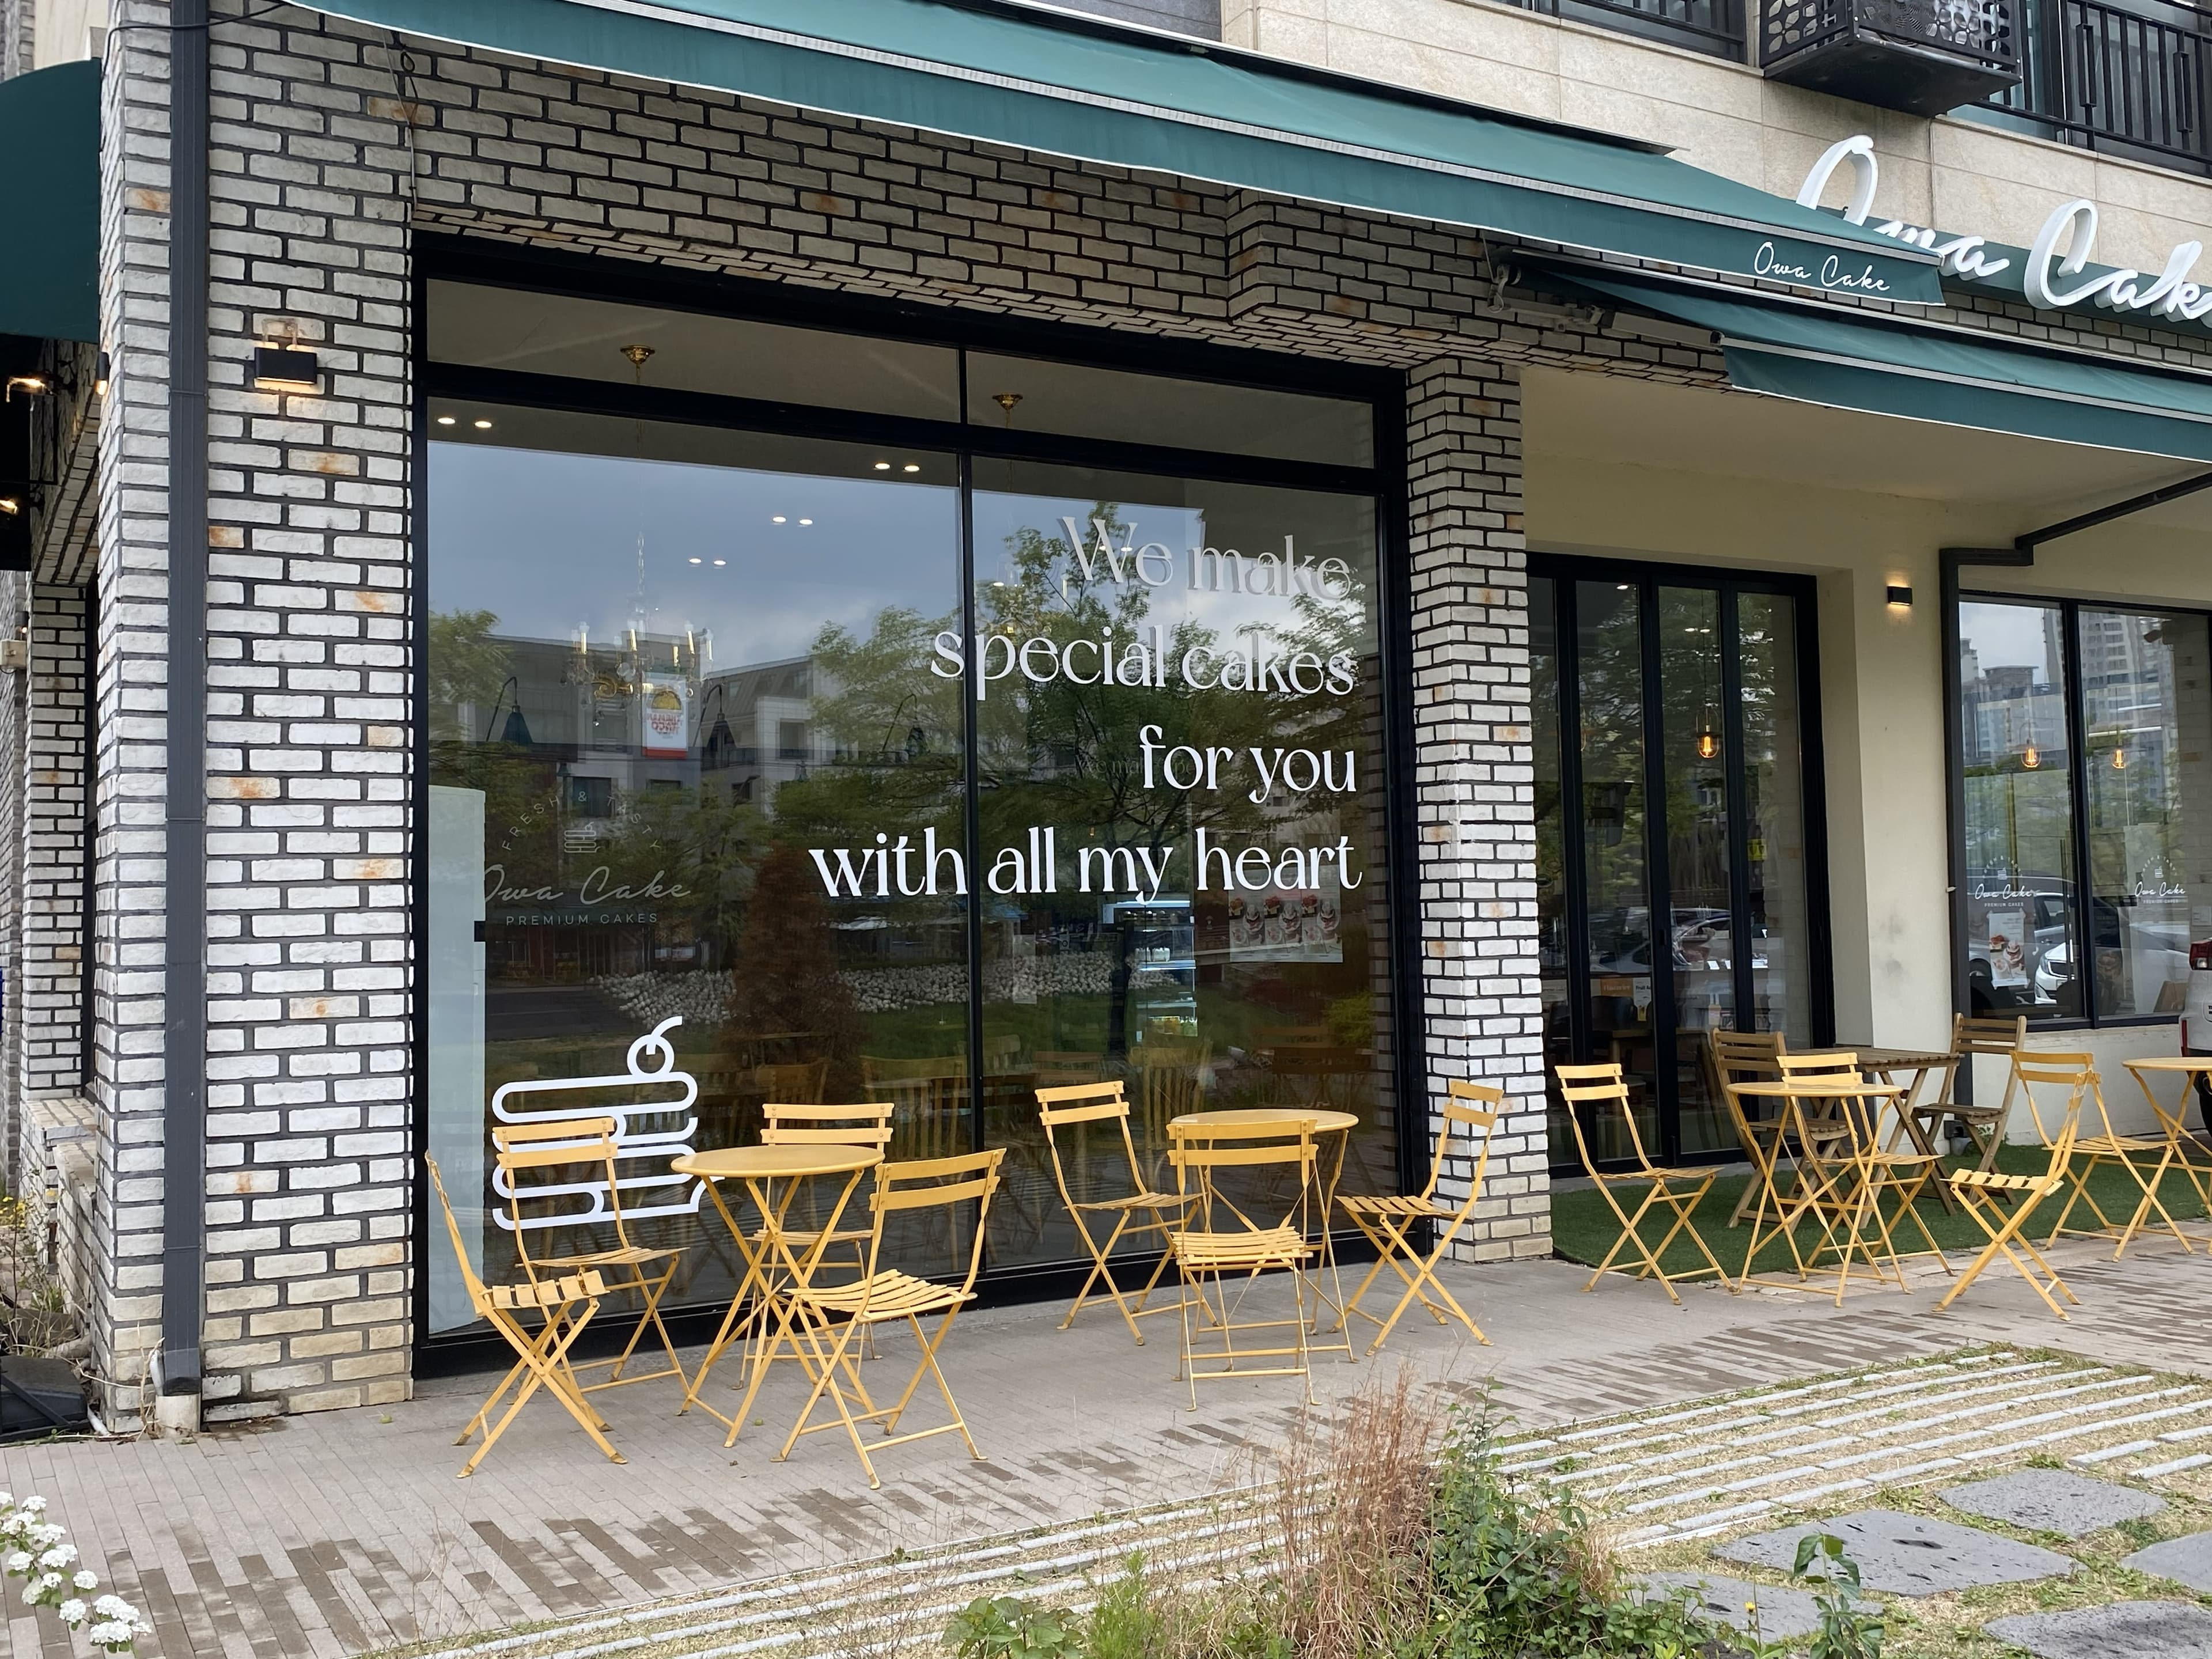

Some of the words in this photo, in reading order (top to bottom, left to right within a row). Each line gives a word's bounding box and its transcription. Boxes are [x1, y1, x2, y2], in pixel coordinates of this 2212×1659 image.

[1754, 241, 1812, 279] Owa
[1821, 255, 1890, 291] Cake
[2024, 199, 2212, 328] Cak
[1060, 516, 1173, 585] We
[1188, 535, 1352, 600] make
[930, 626, 1165, 700] special
[1182, 631, 1356, 695] cakes
[1139, 725, 1233, 790] for
[1248, 747, 1357, 804] you
[502, 795, 560, 851] FRESH
[578, 791, 588, 802] &
[607, 795, 661, 850] TASTY
[580, 866, 691, 905] Cake
[808, 827, 968, 898] with
[987, 826, 1058, 895] all
[1078, 846, 1174, 904] my
[1194, 827, 1363, 891] heart
[506, 914, 589, 926] PREMIUM
[600, 912, 658, 924] CAKES
